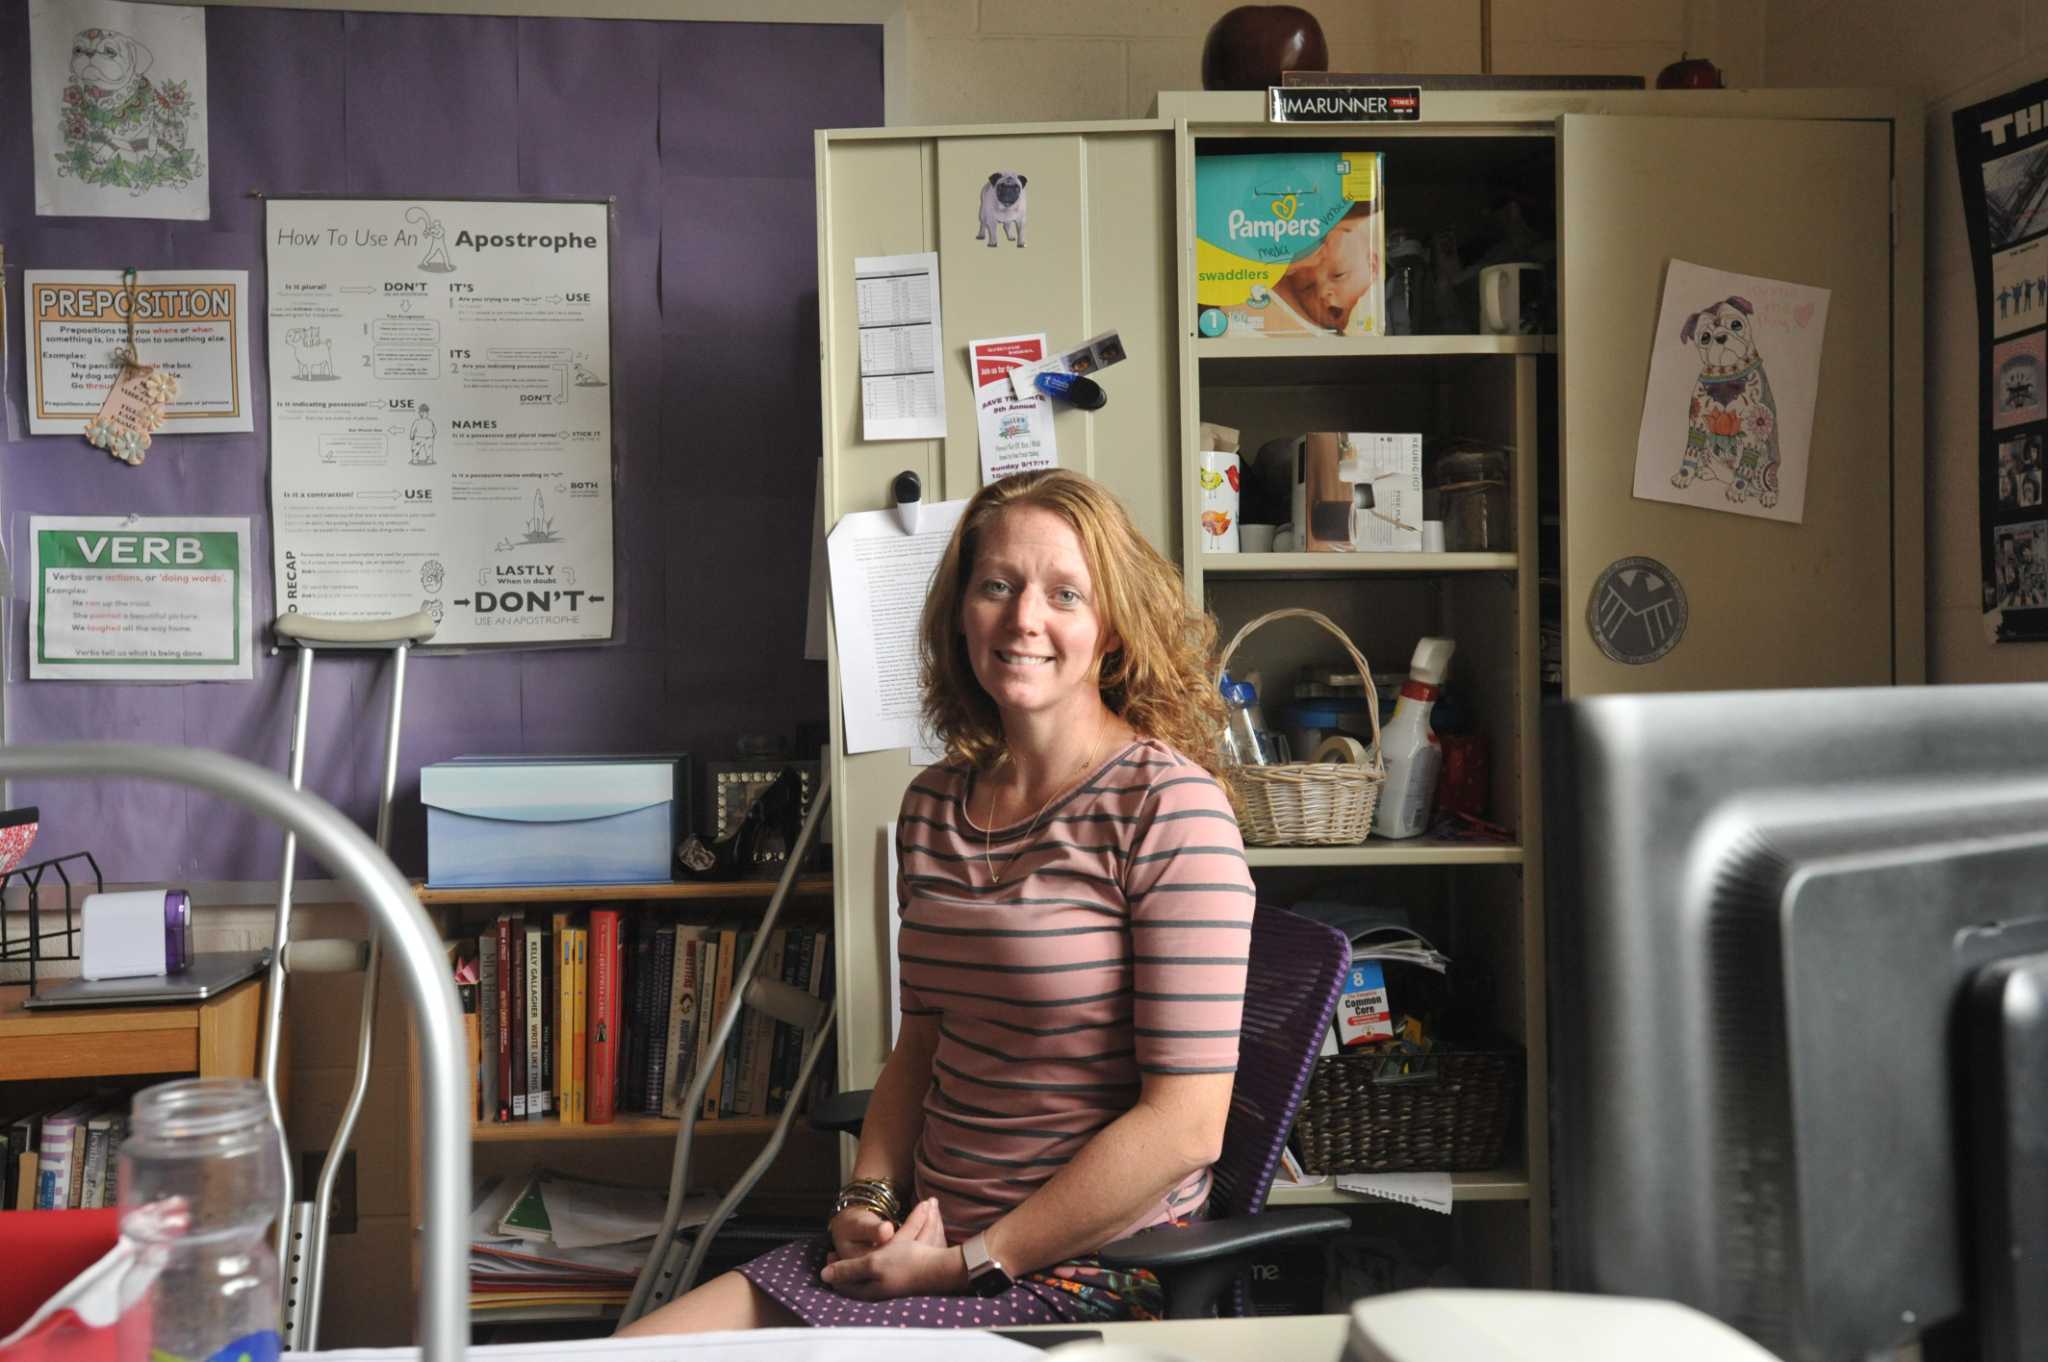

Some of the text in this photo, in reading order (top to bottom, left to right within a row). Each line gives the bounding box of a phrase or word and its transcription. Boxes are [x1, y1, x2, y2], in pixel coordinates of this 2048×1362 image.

[1980, 100, 2048, 146] TH
[1228, 209, 1321, 242] Pampers
[277, 228, 598, 253] How To Use An Apostrophe
[1199, 269, 1270, 281] swaddlers
[384, 282, 428, 291] DON'T
[449, 283, 474, 293] IT'S
[39, 288, 232, 319] PREPOSITION
[565, 293, 591, 302] USE
[1208, 311, 1217, 329] 1
[60, 325, 116, 335] Prepositions
[450, 350, 471, 359] ITS
[389, 399, 415, 408] USE
[520, 394, 552, 402] DON'T
[452, 420, 497, 429] NAMES
[404, 489, 433, 499] USE
[76, 536, 204, 564] VERB
[53, 572, 83, 581] Verbs
[286, 551, 298, 599] RECAP
[496, 565, 554, 576] LASTLY
[474, 590, 585, 613] DON'T
[512, 615, 580, 625] APOSTROPHE
[530, 941, 538, 967] KELLY
[1353, 972, 1364, 987] 8
[530, 968, 538, 1018] GALLAGHER
[1345, 996, 1382, 1008] Common
[530, 1023, 538, 1049] WRITE
[530, 1051, 538, 1069] LIKE
